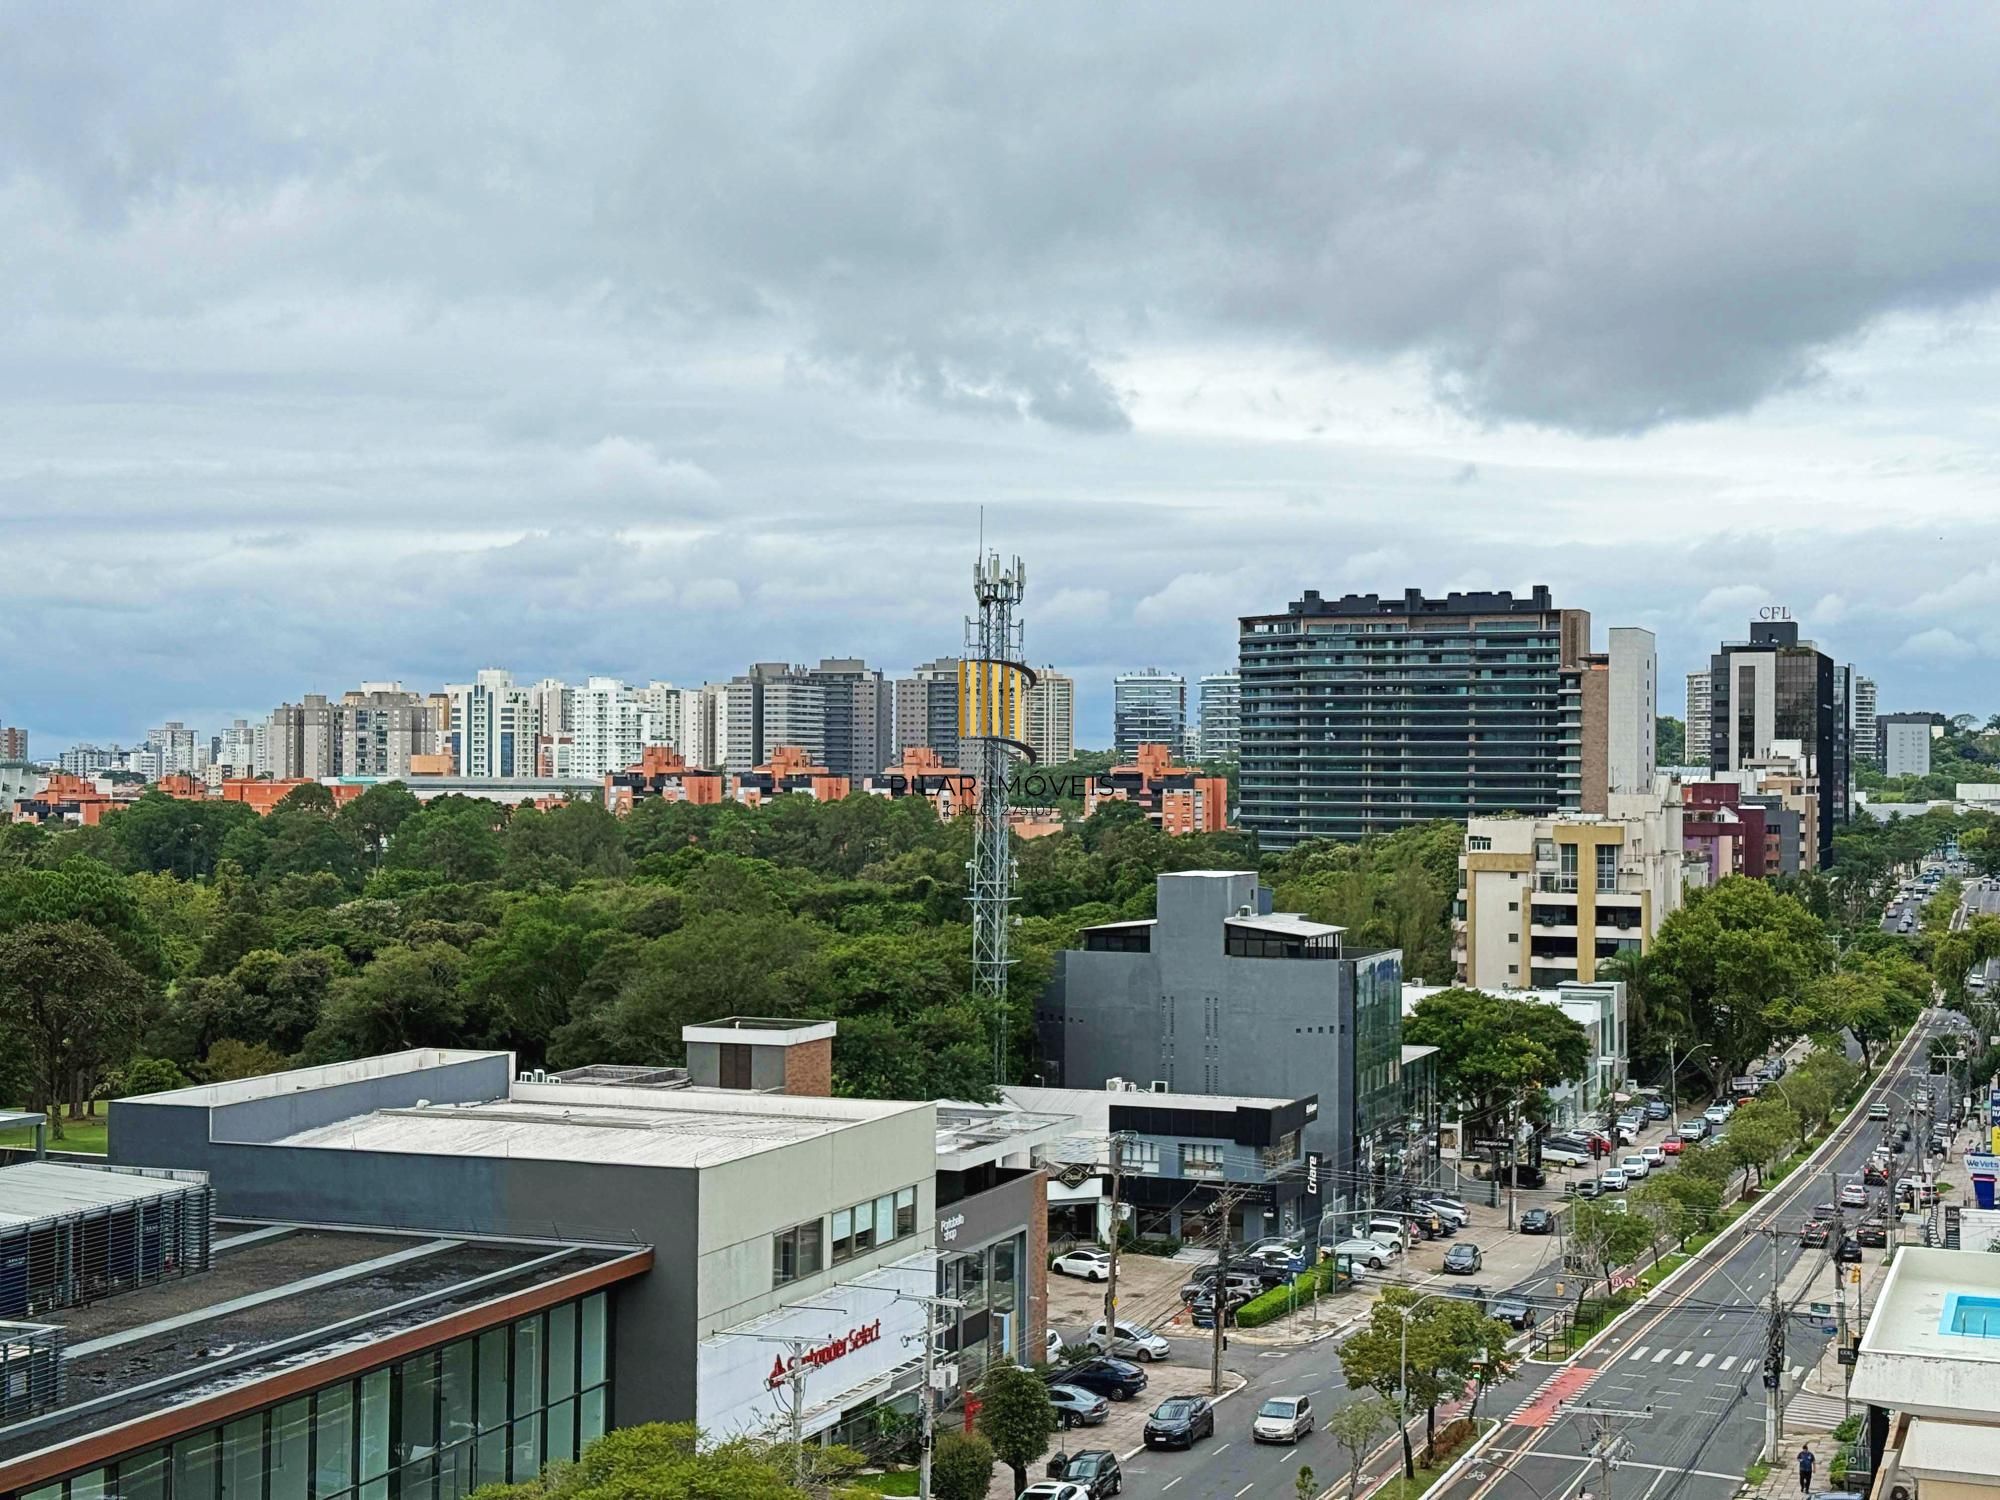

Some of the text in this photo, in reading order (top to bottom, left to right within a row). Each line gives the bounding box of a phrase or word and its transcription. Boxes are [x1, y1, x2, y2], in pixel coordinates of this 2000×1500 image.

[1760, 606, 1791, 620] CFL
[1307, 1155, 1317, 1195] Criare
[1966, 1159, 1999, 1168] We Vets
[787, 1318, 881, 1371] Sntander Select
